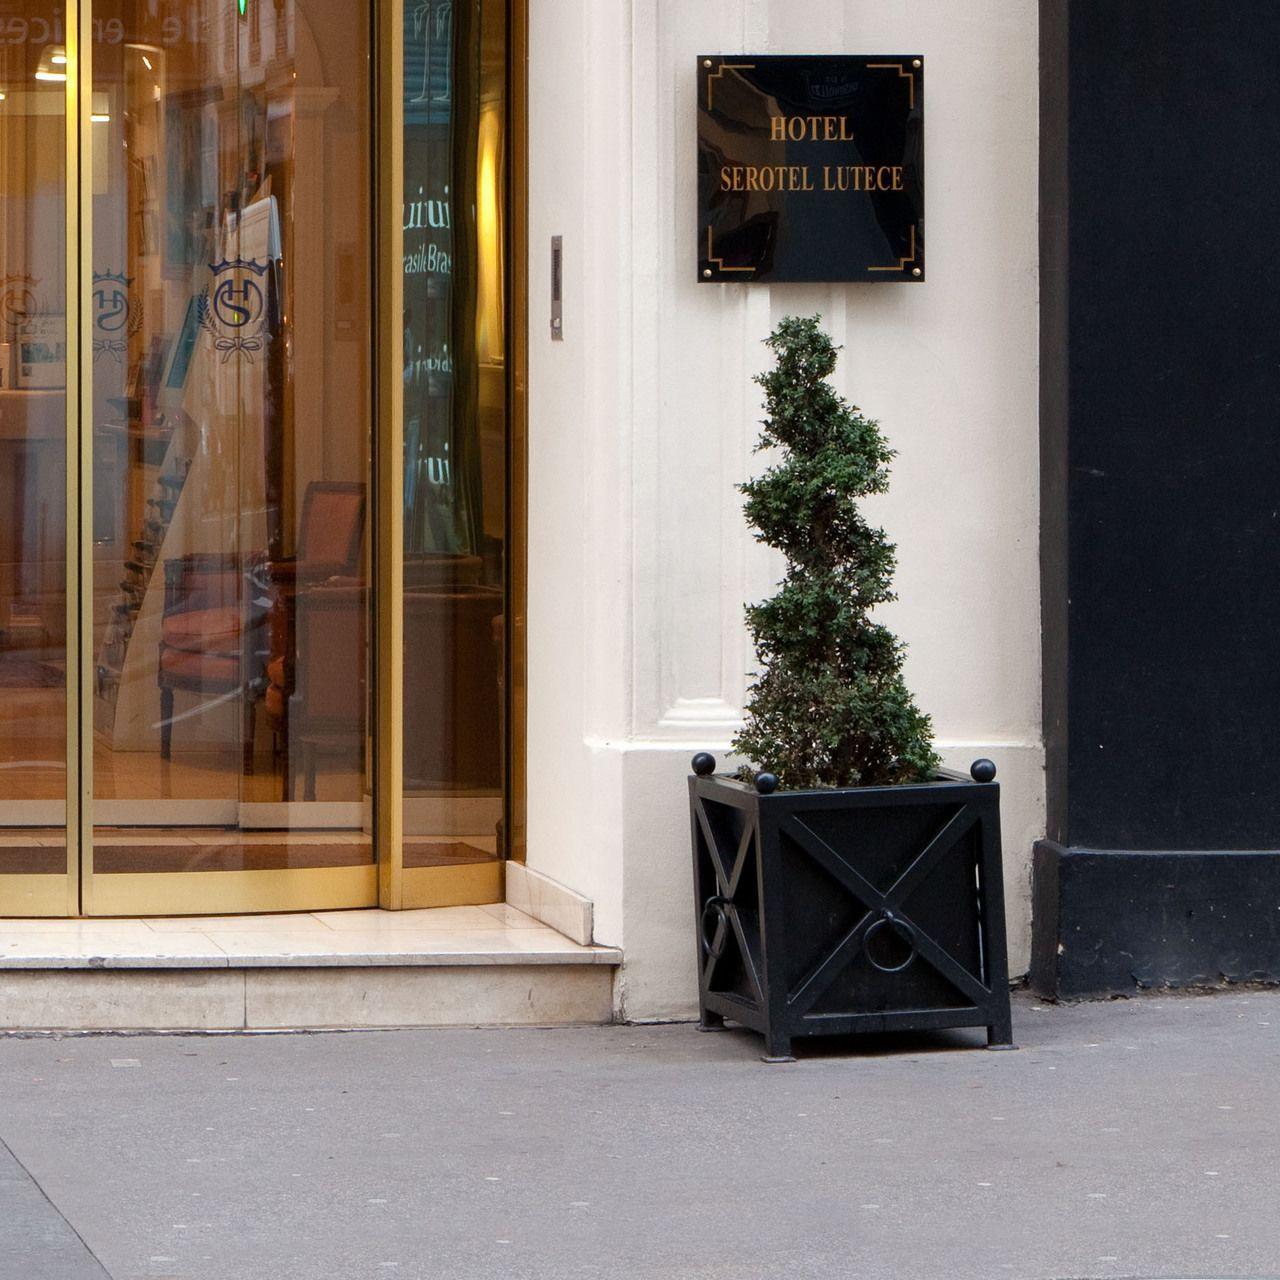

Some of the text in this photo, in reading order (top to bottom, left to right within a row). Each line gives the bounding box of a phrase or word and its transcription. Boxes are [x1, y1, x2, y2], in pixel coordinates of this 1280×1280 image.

[770, 116, 854, 141] HOTEL
[720, 166, 904, 191] SEROTEL LUTECE
